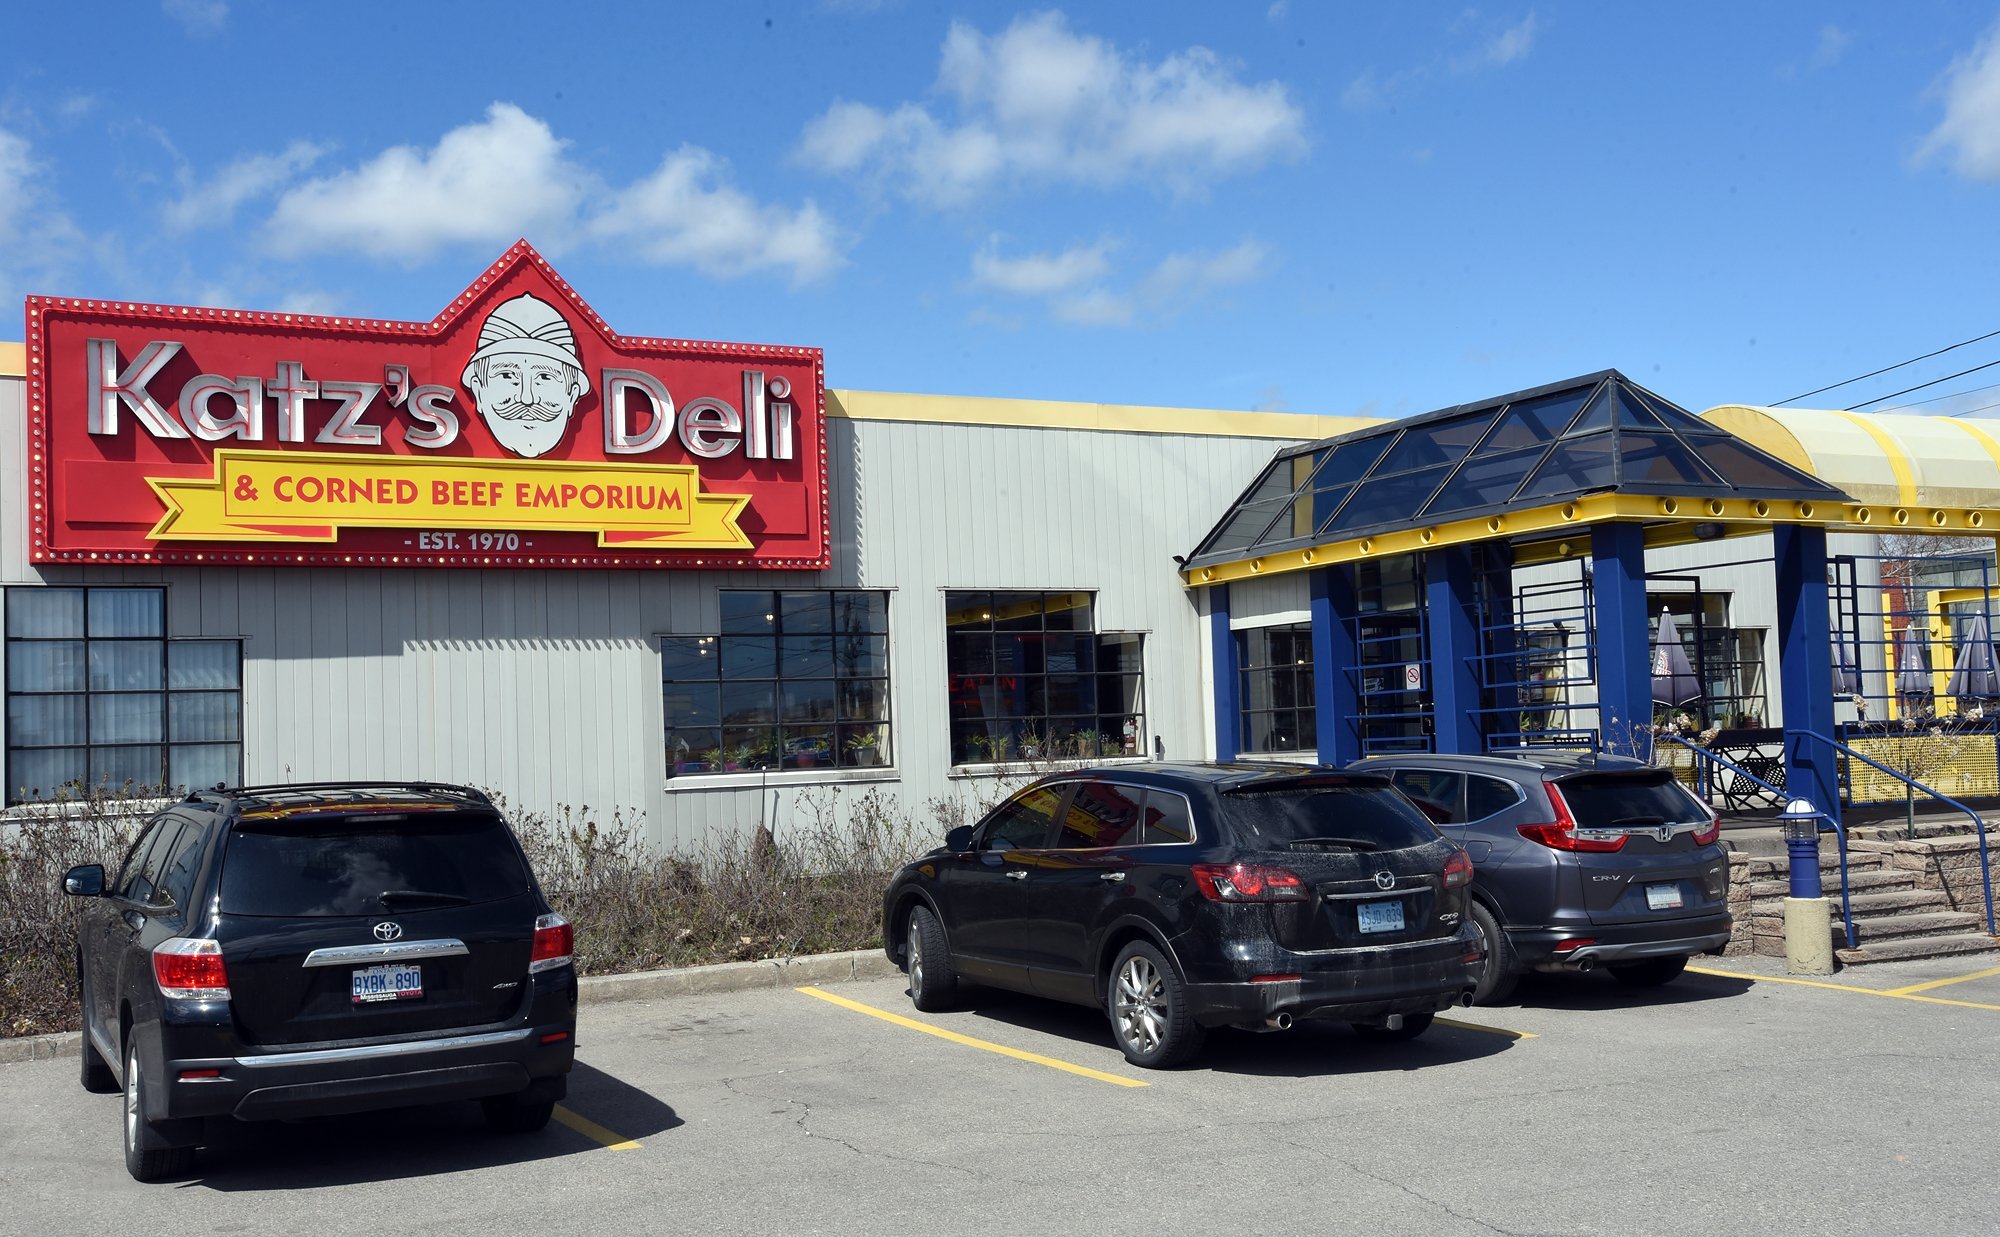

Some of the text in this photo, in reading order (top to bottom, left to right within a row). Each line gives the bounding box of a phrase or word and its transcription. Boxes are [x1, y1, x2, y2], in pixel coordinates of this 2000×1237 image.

[86, 337, 793, 460] Katz's Deli
[233, 474, 683, 511] & CORNED BEEF EMPORIUM
[419, 532, 460, 550] EST.
[468, 533, 519, 551] 1970
[354, 971, 420, 995] BXBK 890
[397, 989, 423, 997] TOYOTA
